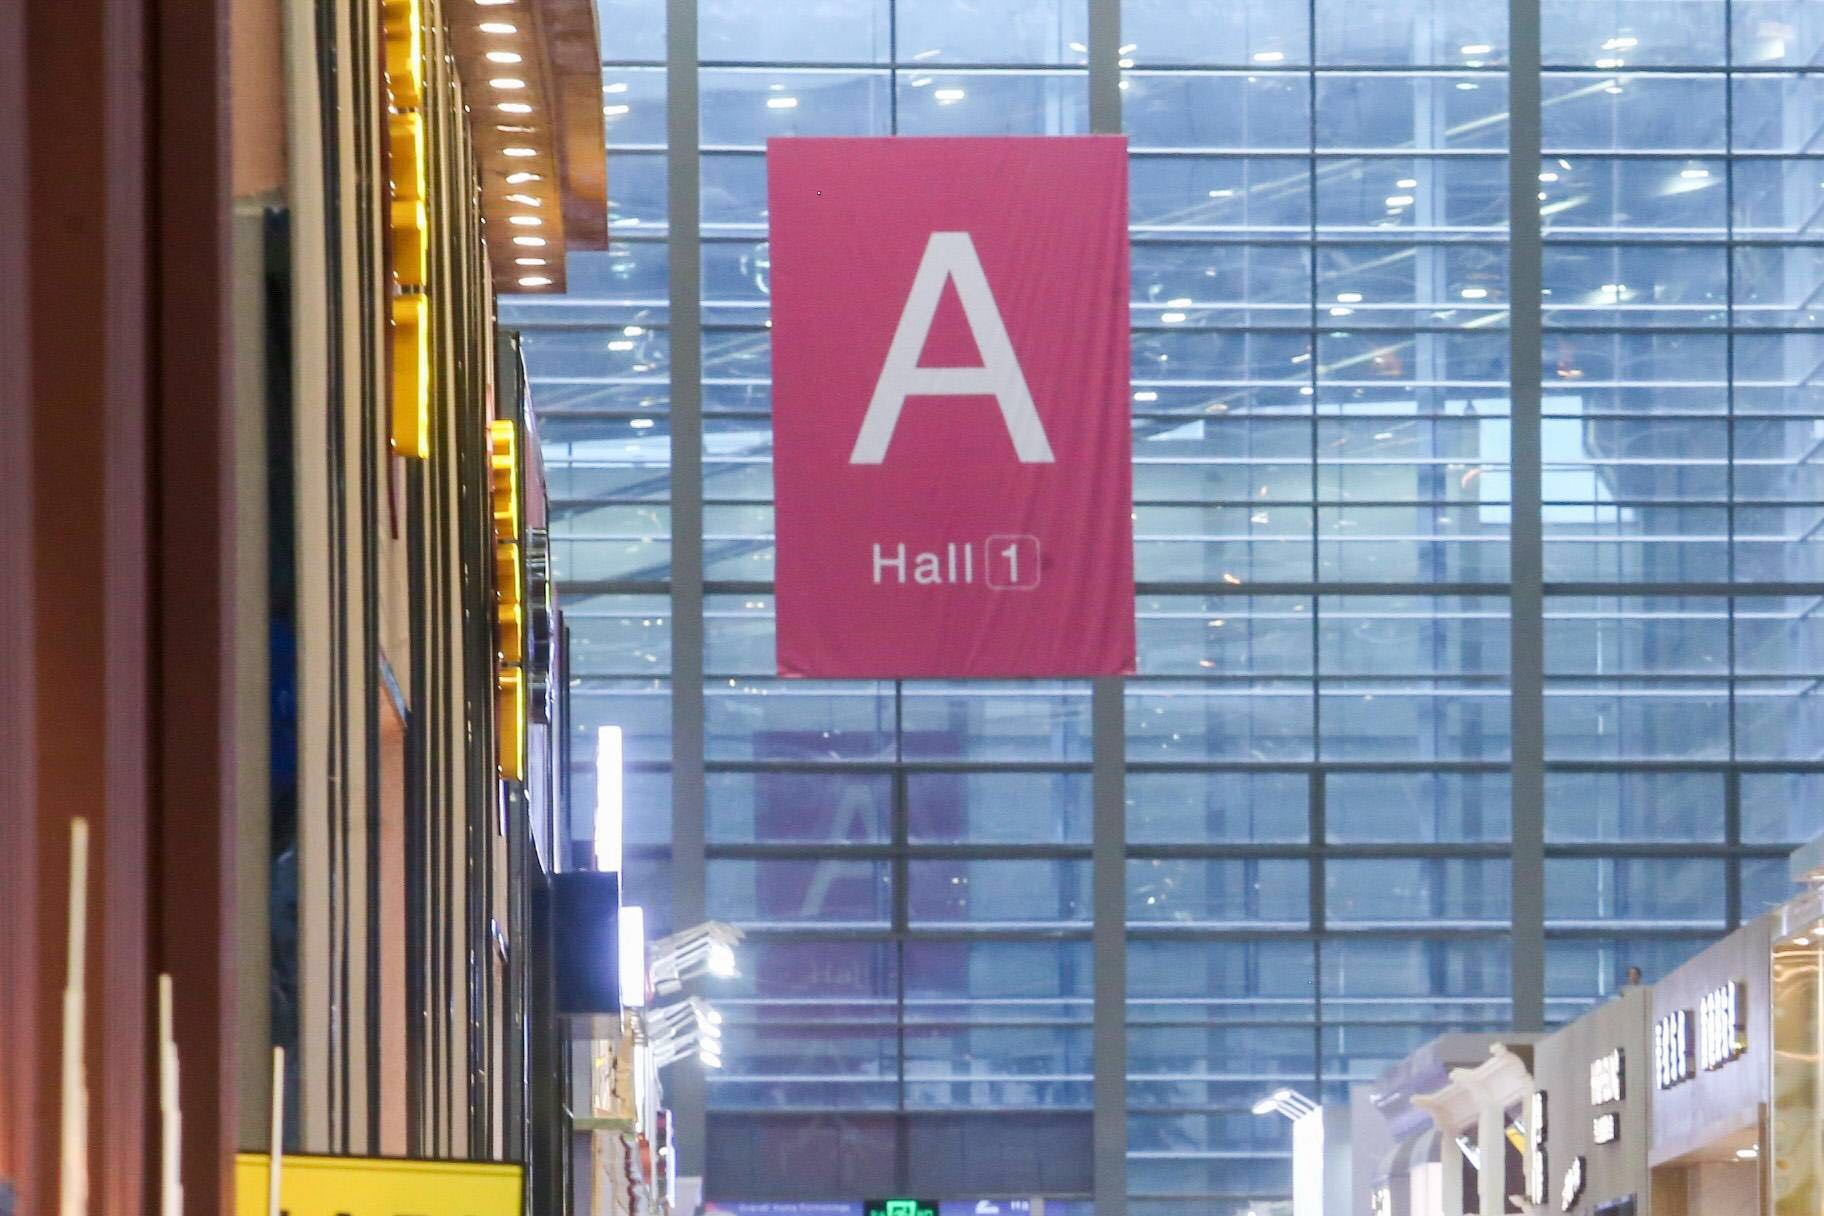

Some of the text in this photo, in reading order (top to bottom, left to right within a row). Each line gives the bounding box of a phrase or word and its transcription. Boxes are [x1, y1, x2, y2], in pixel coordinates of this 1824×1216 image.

[848, 230, 1055, 465] A
[872, 542, 1019, 584] Hall 1
